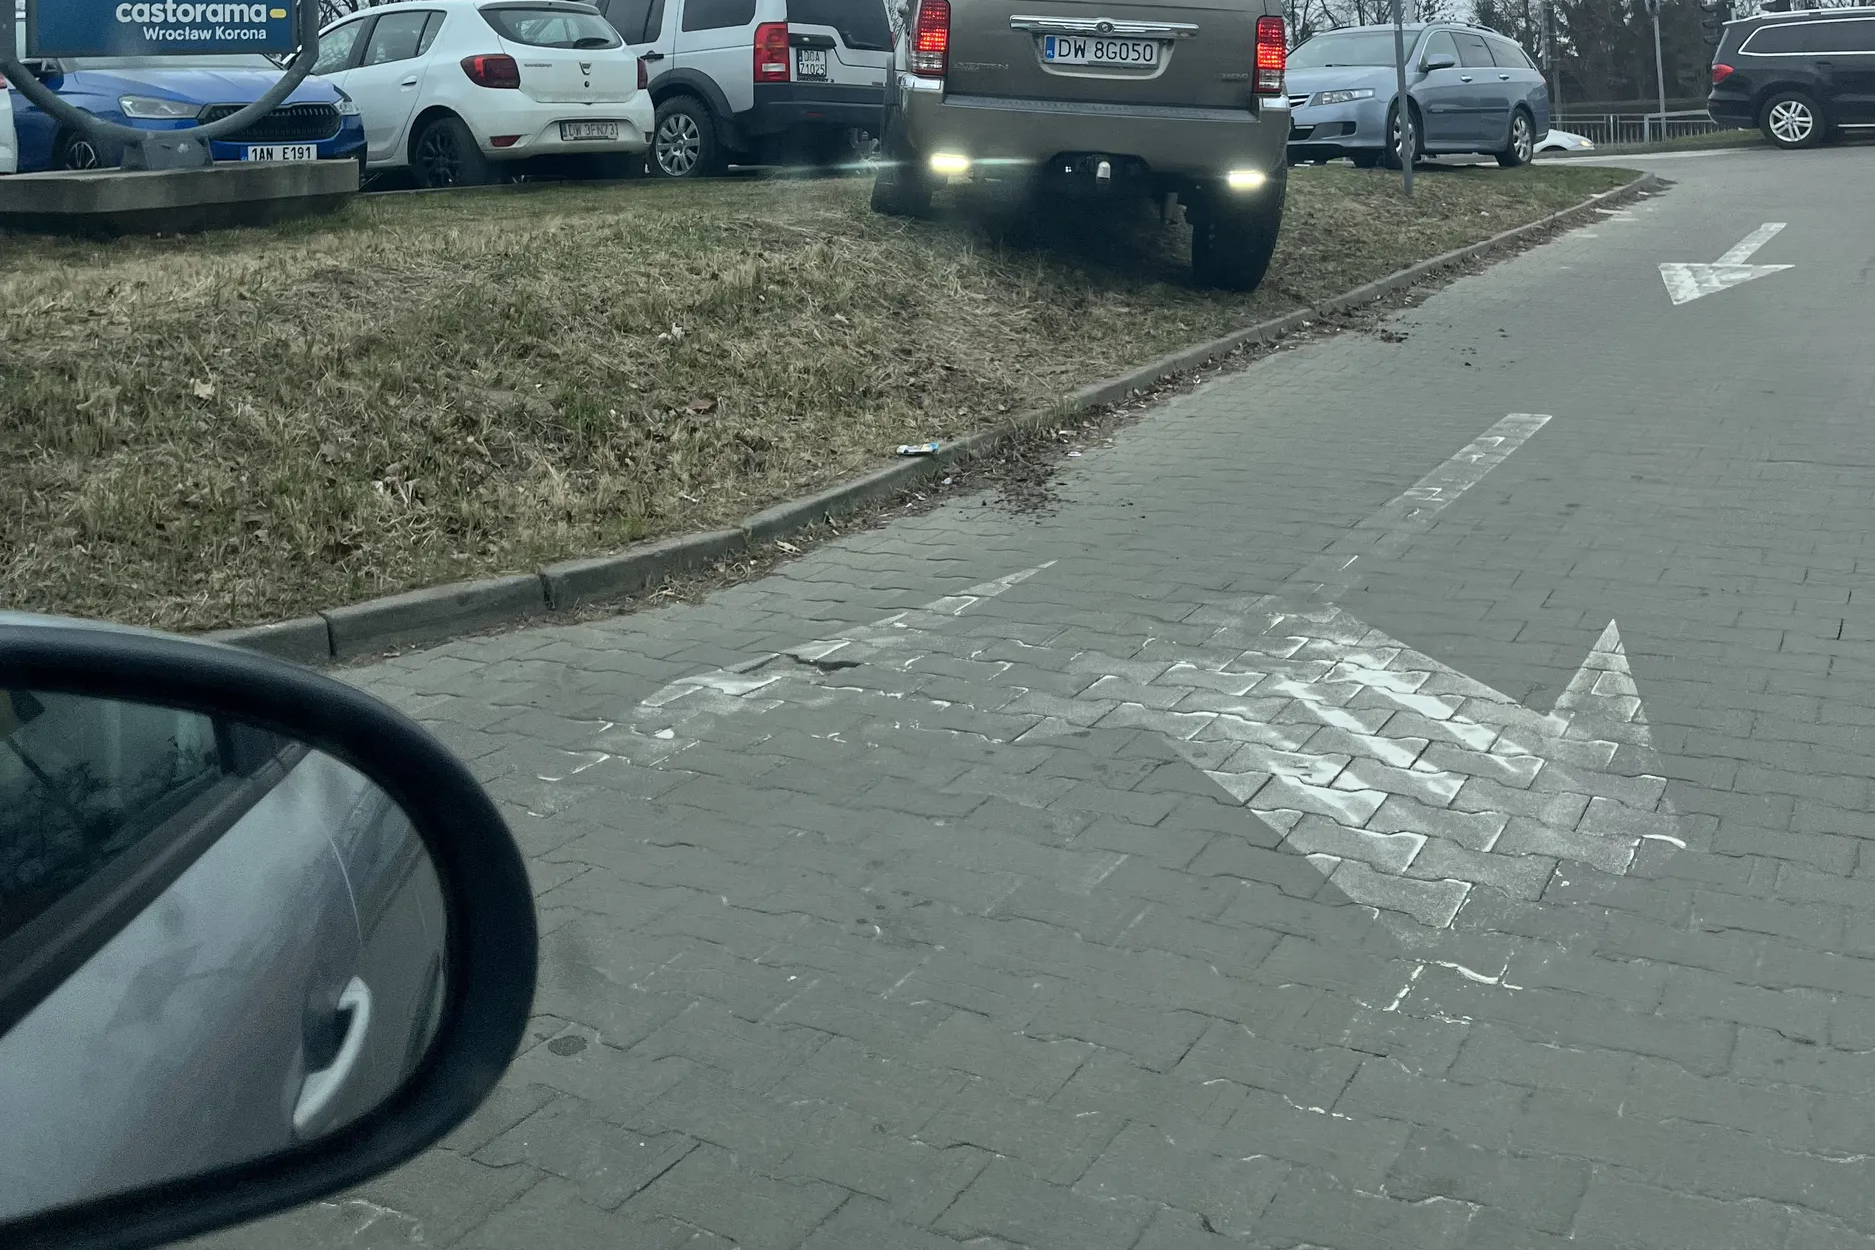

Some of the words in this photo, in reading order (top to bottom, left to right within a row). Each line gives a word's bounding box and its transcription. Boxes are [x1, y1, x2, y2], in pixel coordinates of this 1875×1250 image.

[143, 25, 212, 41] Wrocław
[215, 25, 267, 40] Korona
[1058, 39, 1086, 58] DW
[1094, 41, 1153, 62] 8G050
[799, 63, 825, 75] 71025
[252, 147, 273, 160] 1AN
[282, 146, 311, 160] E191
